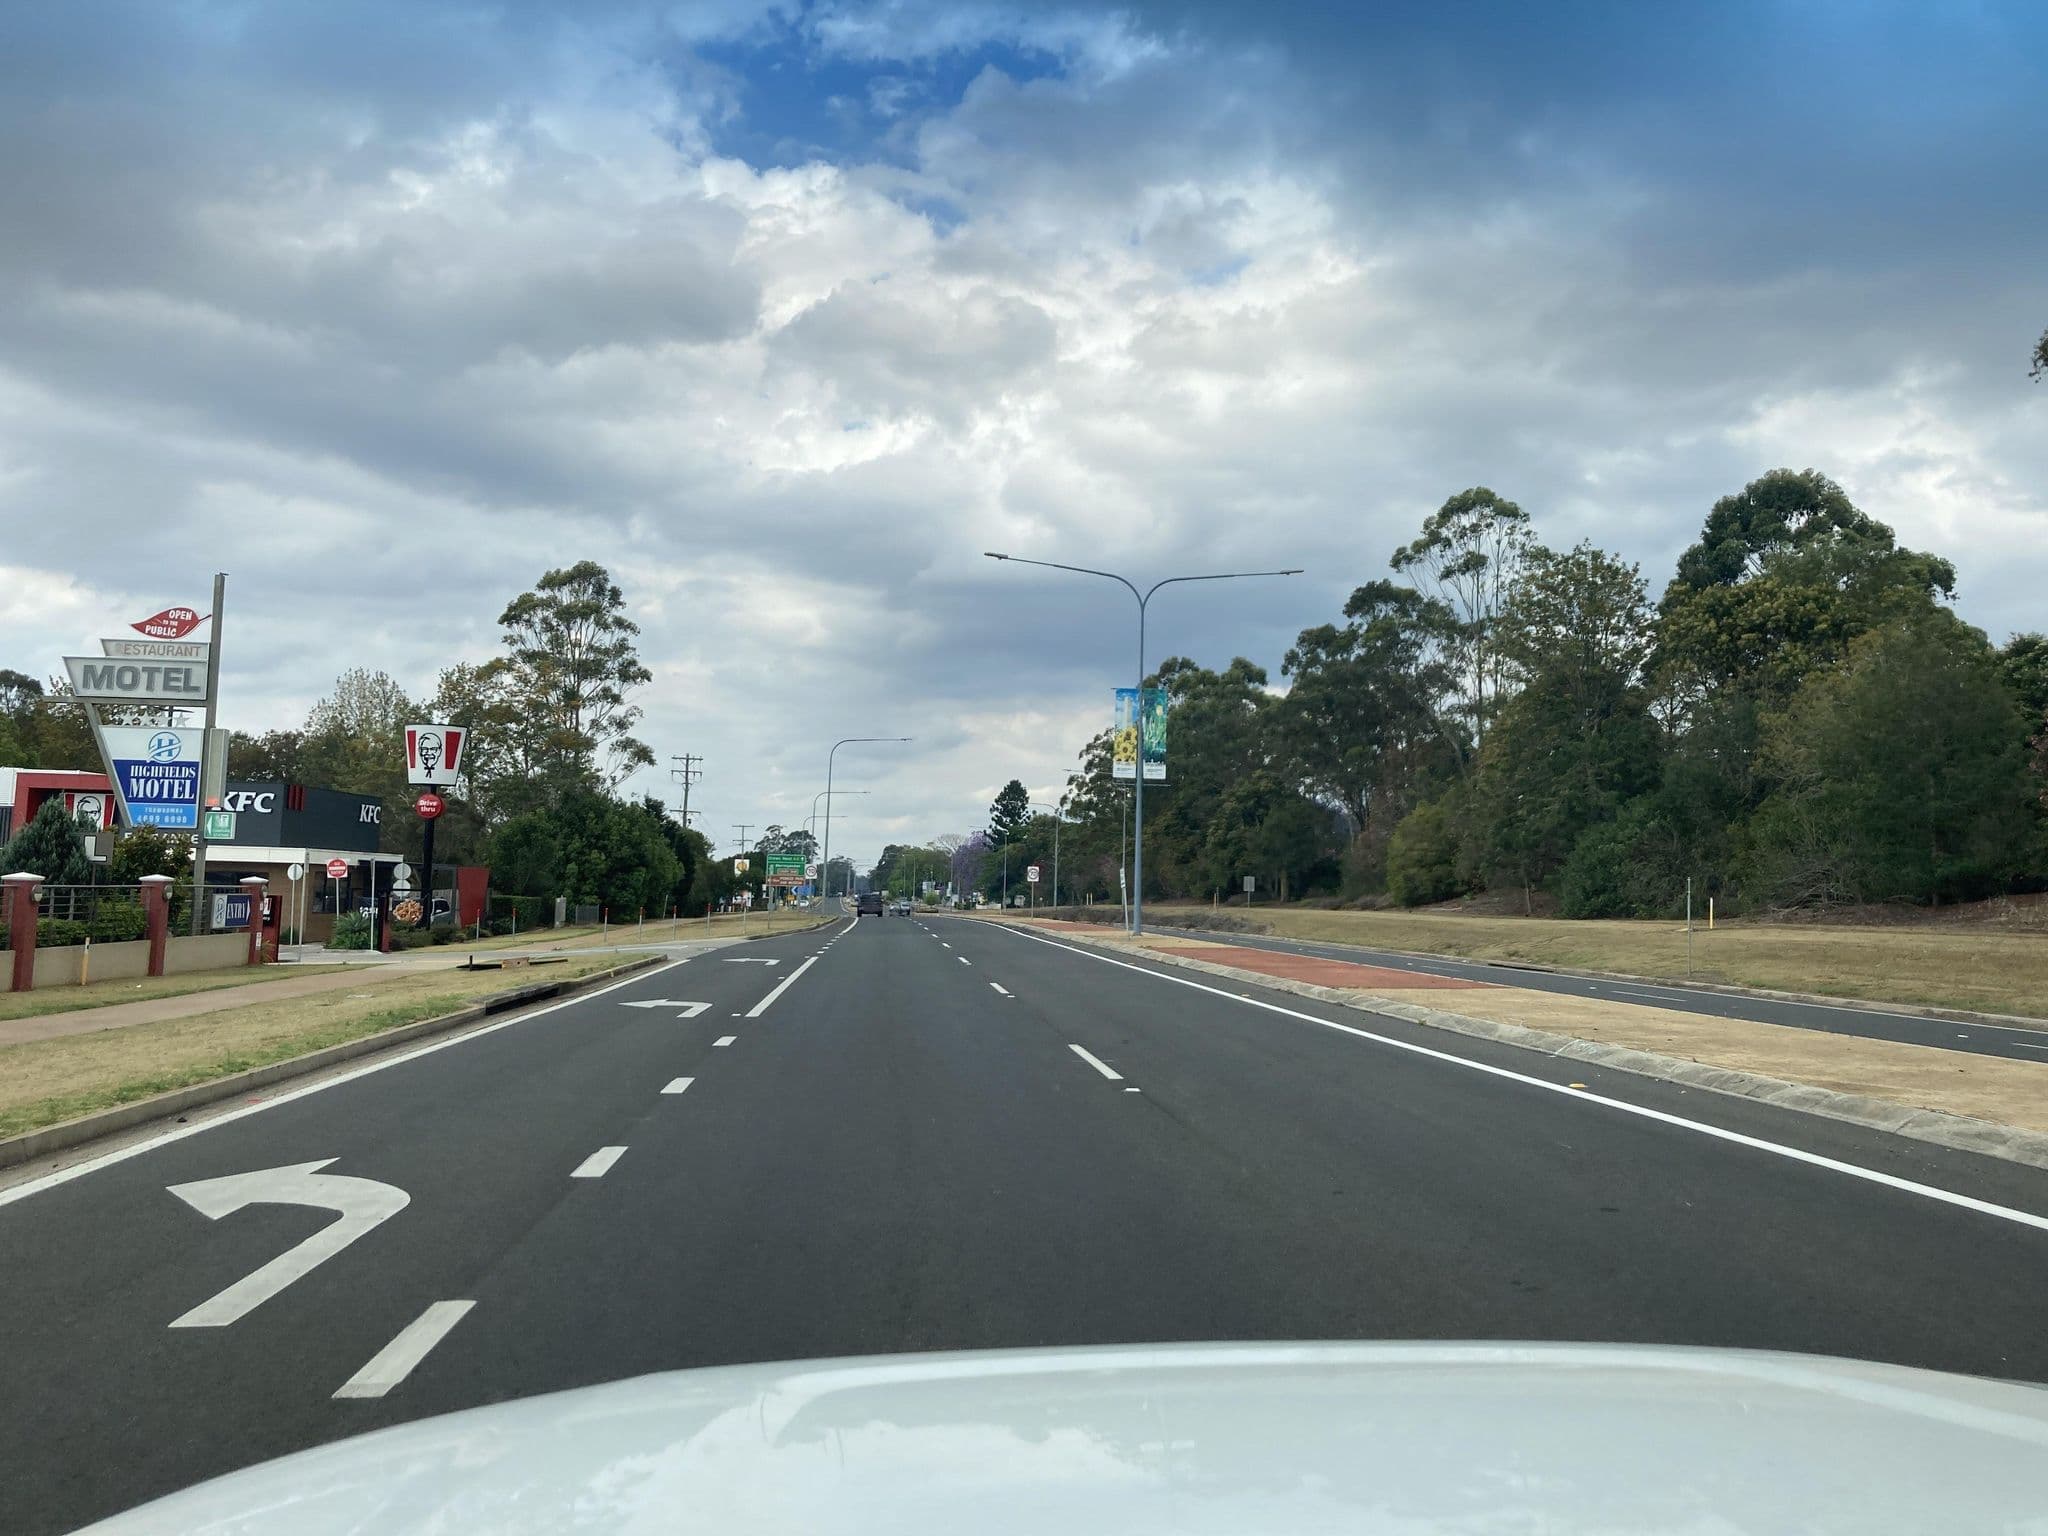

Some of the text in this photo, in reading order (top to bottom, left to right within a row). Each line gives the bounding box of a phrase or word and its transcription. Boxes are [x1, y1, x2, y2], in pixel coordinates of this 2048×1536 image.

[169, 610, 192, 620] OPEN
[145, 625, 177, 637] PUBLIC
[82, 664, 201, 692] MOTEL
[130, 765, 196, 778] HIGHFIELDS
[128, 778, 195, 800] MOTEL
[359, 803, 381, 824] KFC
[227, 902, 245, 919] ENTRY
